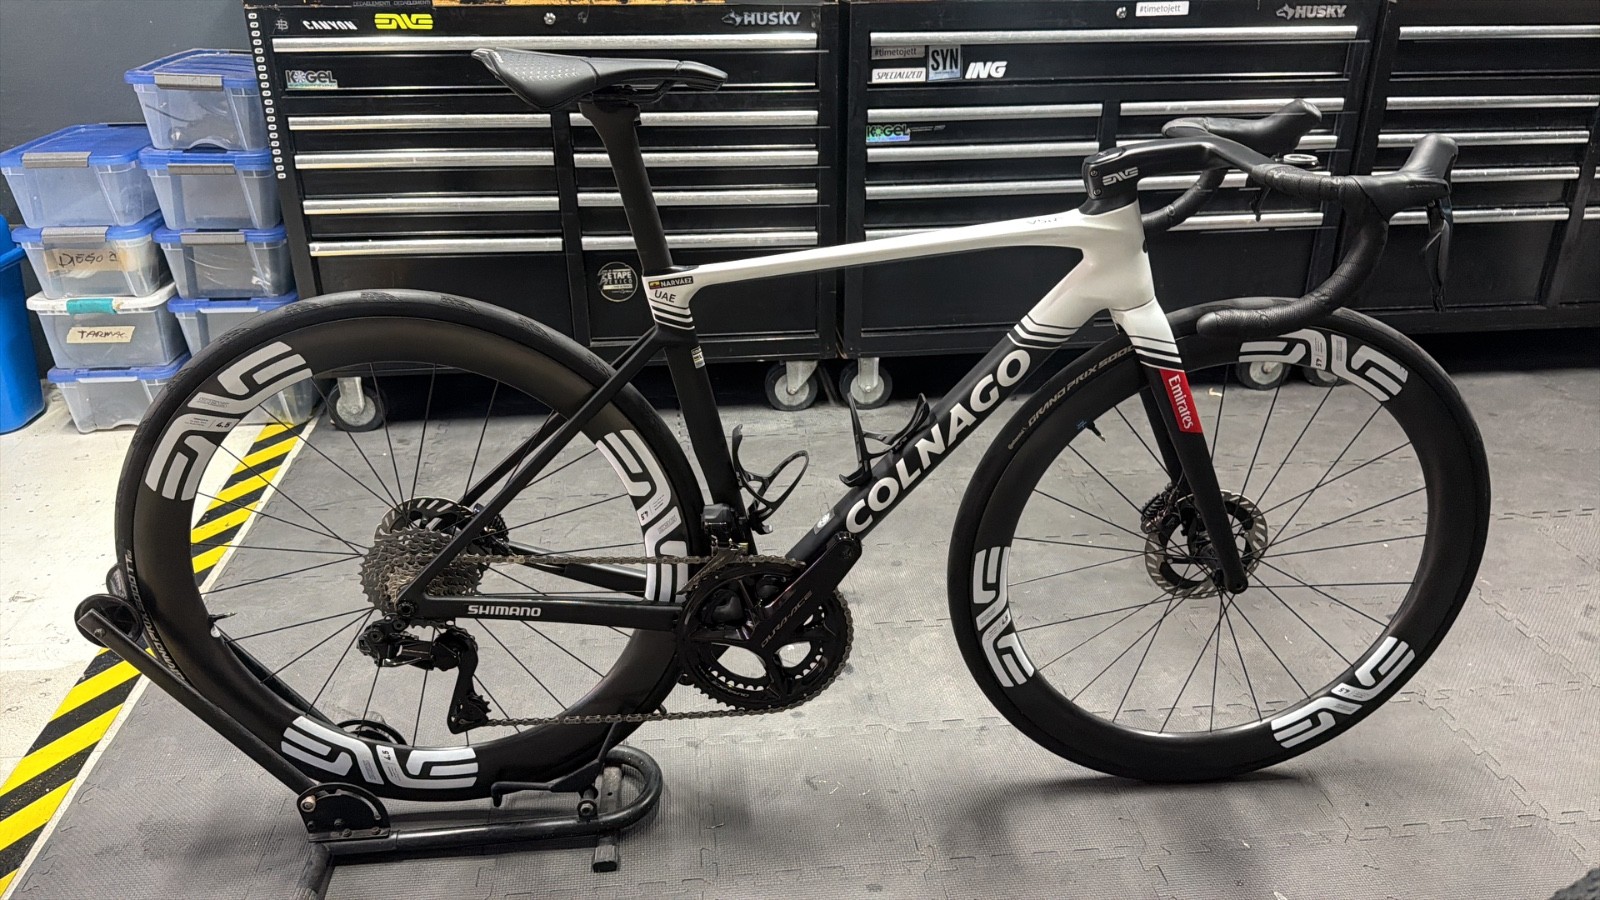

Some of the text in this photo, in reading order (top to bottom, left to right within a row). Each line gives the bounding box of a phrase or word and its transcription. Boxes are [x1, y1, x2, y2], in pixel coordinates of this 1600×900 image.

[1139, 4, 1181, 13] #timetojett
[1294, 4, 1347, 18] HUSKY
[302, 20, 358, 30] CANYON
[374, 13, 434, 30] ENVE
[743, 11, 800, 26] HUSKY
[875, 47, 917, 57] #timetojett
[930, 48, 959, 71] SYN
[876, 70, 923, 80] SPECIALIZED
[965, 61, 1008, 79] ING
[1102, 166, 1139, 186] ENVE
[58, 252, 104, 268] DIEGO
[654, 290, 677, 303] UAE
[1028, 387, 1066, 427] GRAND
[1066, 366, 1098, 392] PRIX
[1168, 374, 1194, 430] Emirates
[215, 421, 231, 429] 4.5
[845, 349, 1031, 533] COLNAGO
[467, 605, 542, 618] SHIMANO
